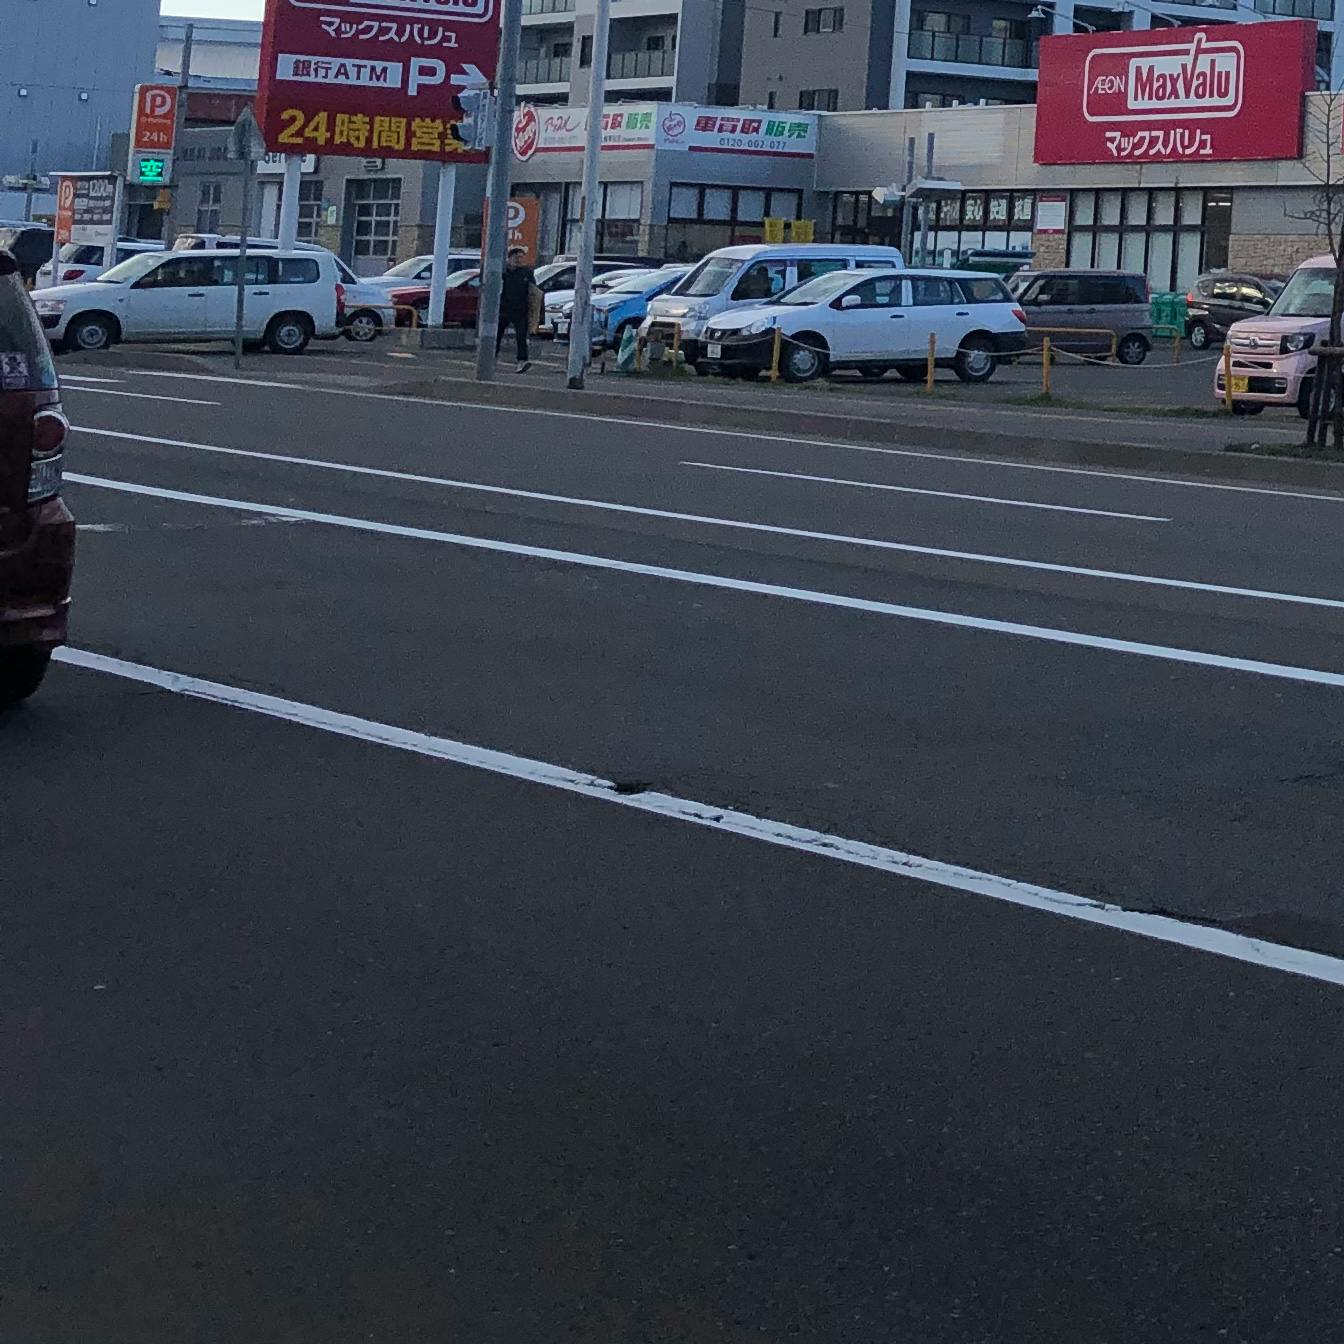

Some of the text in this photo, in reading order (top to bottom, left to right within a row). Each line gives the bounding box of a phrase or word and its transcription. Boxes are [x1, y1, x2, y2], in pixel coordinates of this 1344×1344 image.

[319, 16, 458, 48] マックスバリュ
[292, 56, 446, 96] 銀行ATM P
[1133, 37, 1231, 101] MaxValu
[693, 115, 763, 135] 車買取
[764, 119, 810, 139] 販売
[1105, 128, 1213, 156] マックスバリュ
